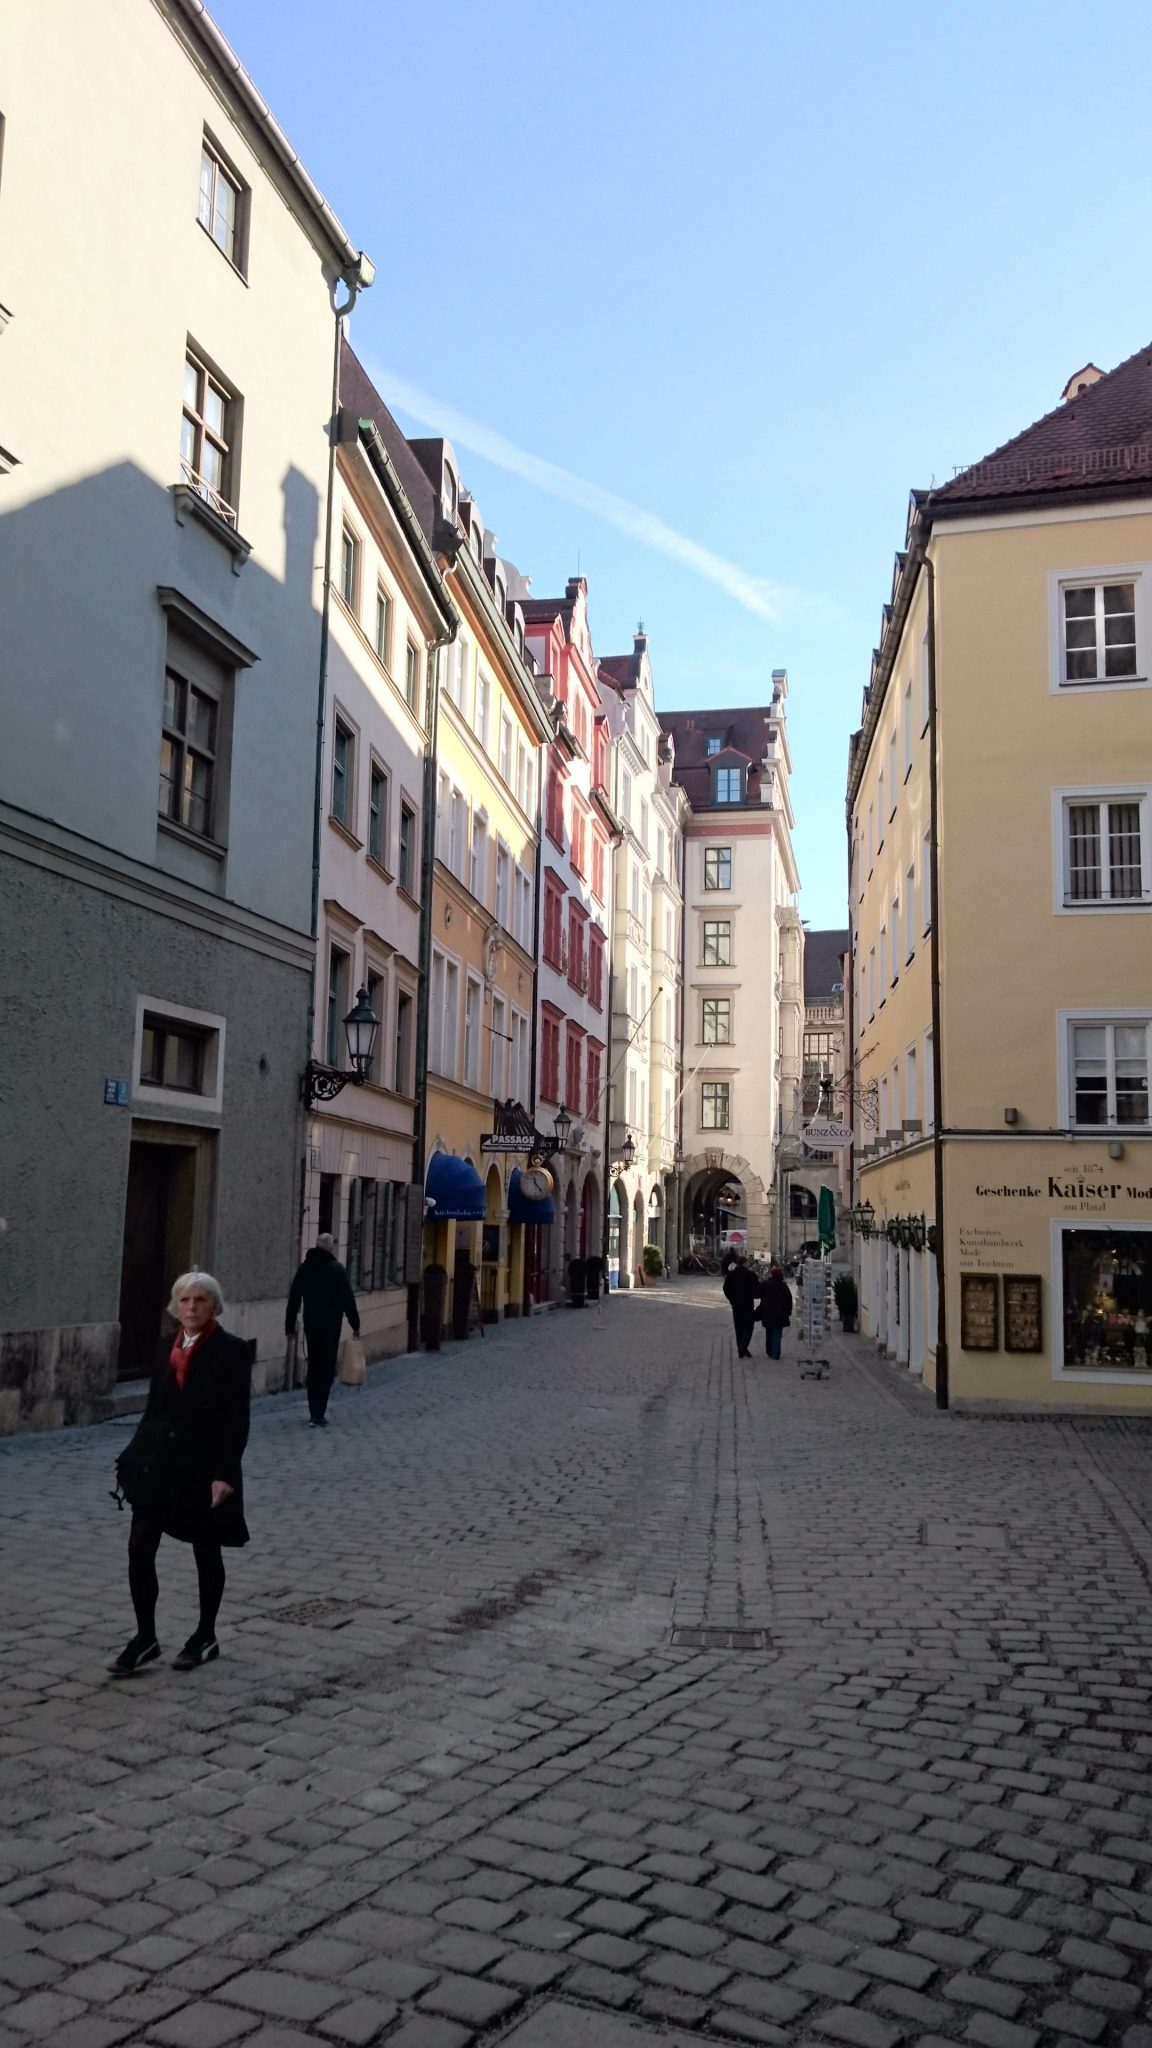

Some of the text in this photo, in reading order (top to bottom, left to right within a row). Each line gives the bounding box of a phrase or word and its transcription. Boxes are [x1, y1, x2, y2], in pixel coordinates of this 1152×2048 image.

[805, 1124, 852, 1137] BUNZ&CO
[492, 1134, 535, 1144] PASSAGE
[975, 1185, 1042, 1197] Geschenke
[1047, 1176, 1122, 1199] Kaiser
